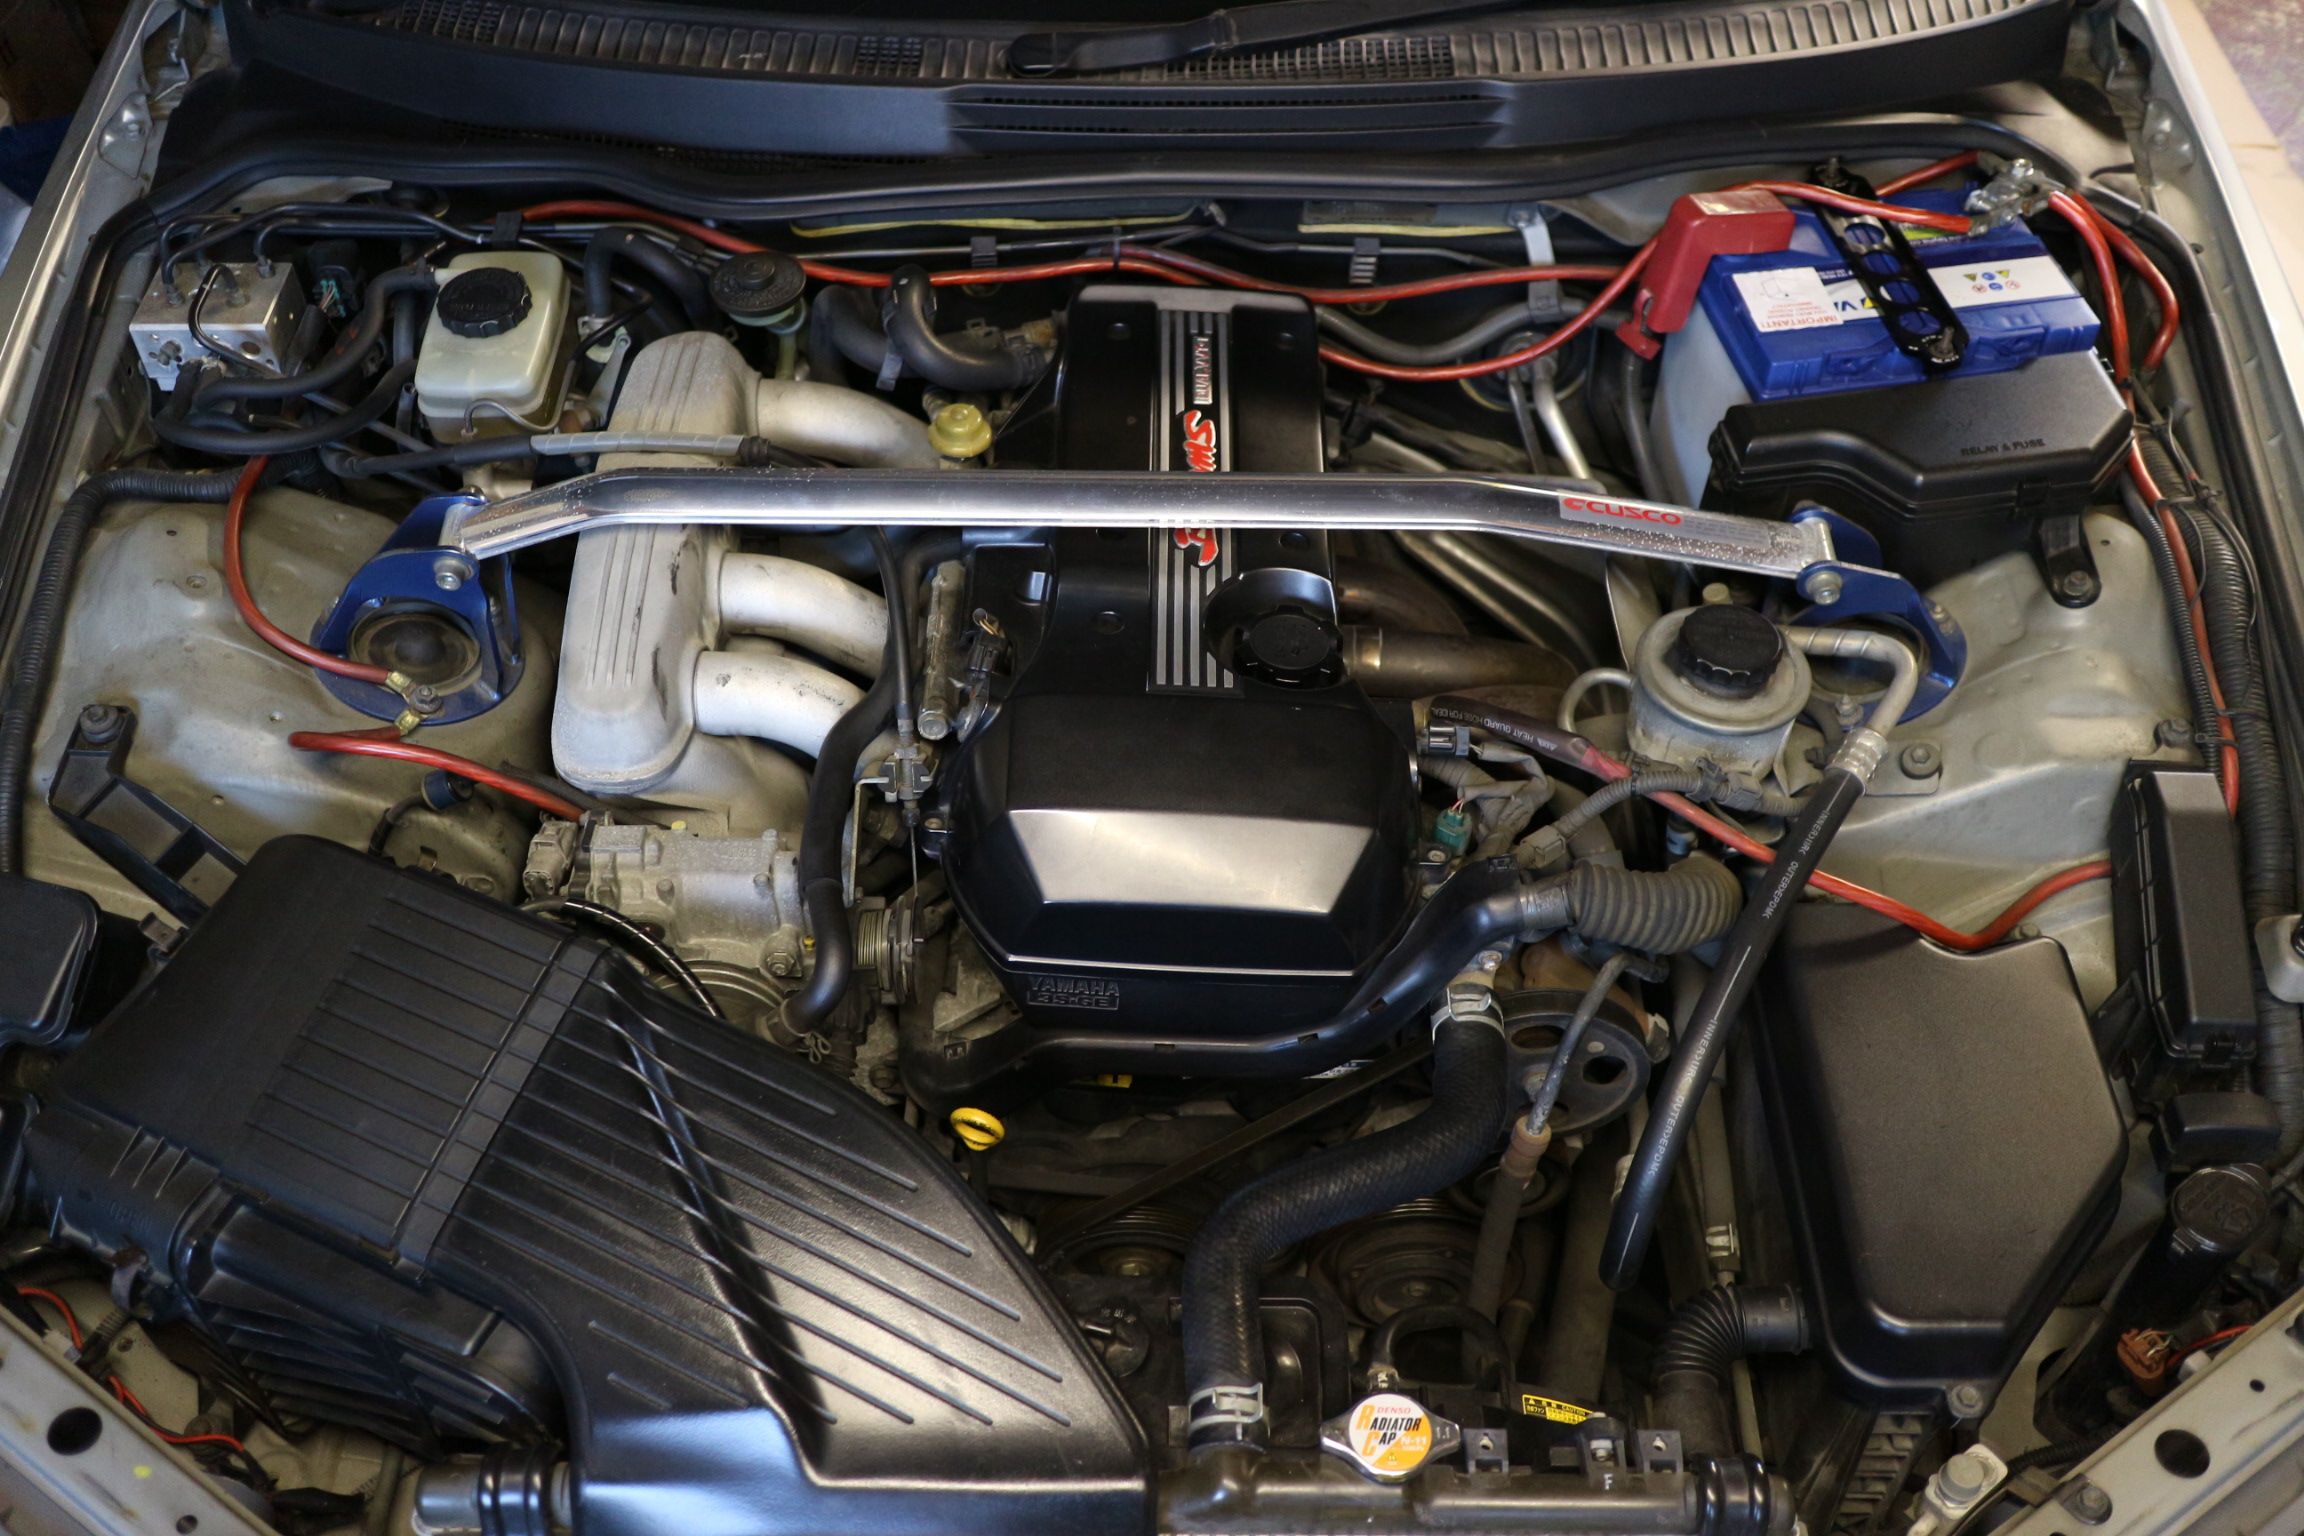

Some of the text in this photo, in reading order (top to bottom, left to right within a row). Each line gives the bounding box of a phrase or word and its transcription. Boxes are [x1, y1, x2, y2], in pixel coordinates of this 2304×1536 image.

[2012, 438, 2046, 450] FUSE
[1586, 500, 1682, 526] CUSCO
[1448, 709, 1463, 721] FOR
[1484, 717, 1511, 733] GUARD
[1512, 728, 1534, 743] HEAT
[1029, 976, 1120, 996] YAMAHA
[1356, 1404, 1422, 1431] RADIATOR
[1376, 1406, 1411, 1415] DENSO
[1362, 1431, 1397, 1457] CAP
